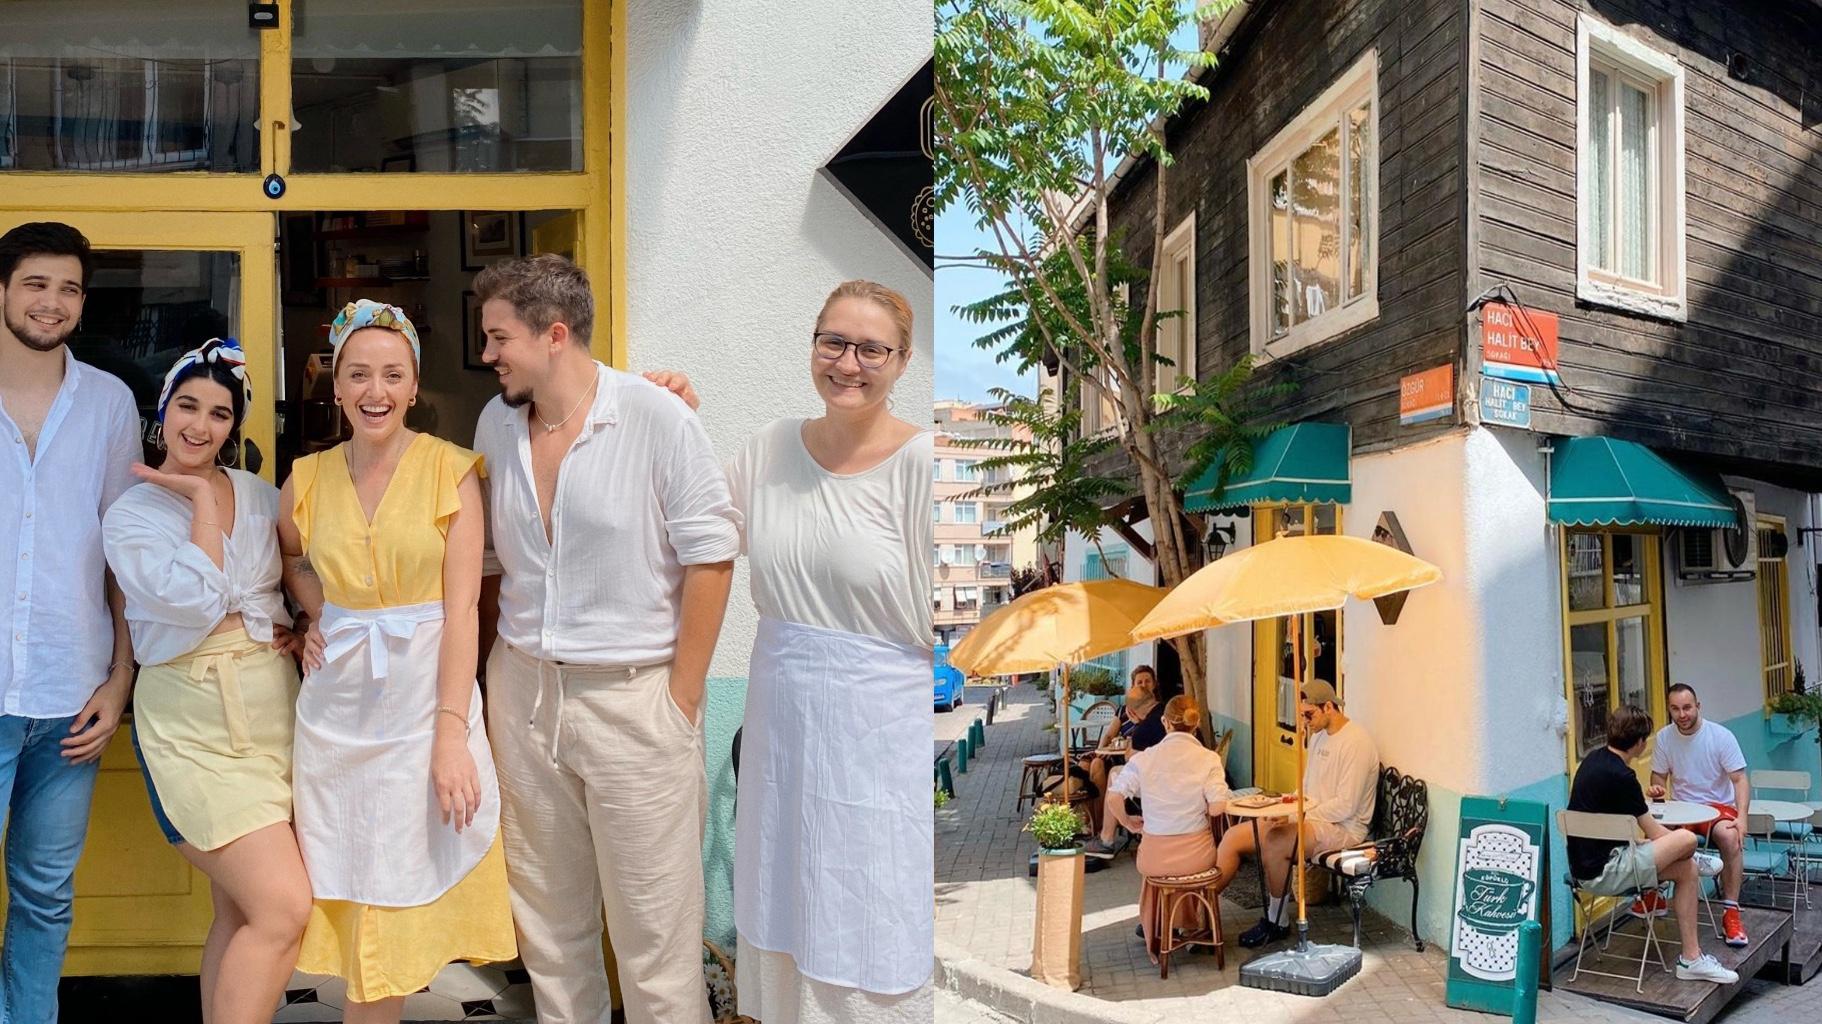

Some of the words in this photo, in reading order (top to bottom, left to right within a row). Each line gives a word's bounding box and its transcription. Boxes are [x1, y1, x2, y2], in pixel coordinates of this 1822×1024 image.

[1487, 311, 1513, 328] HACI
[1520, 337, 1540, 352] BEY
[1493, 384, 1515, 401] HACI
[1494, 409, 1517, 421] SOKAK
[1513, 401, 1526, 412] BEY
[1471, 885, 1509, 904] Türk
[1468, 901, 1517, 919] Kahvesi
